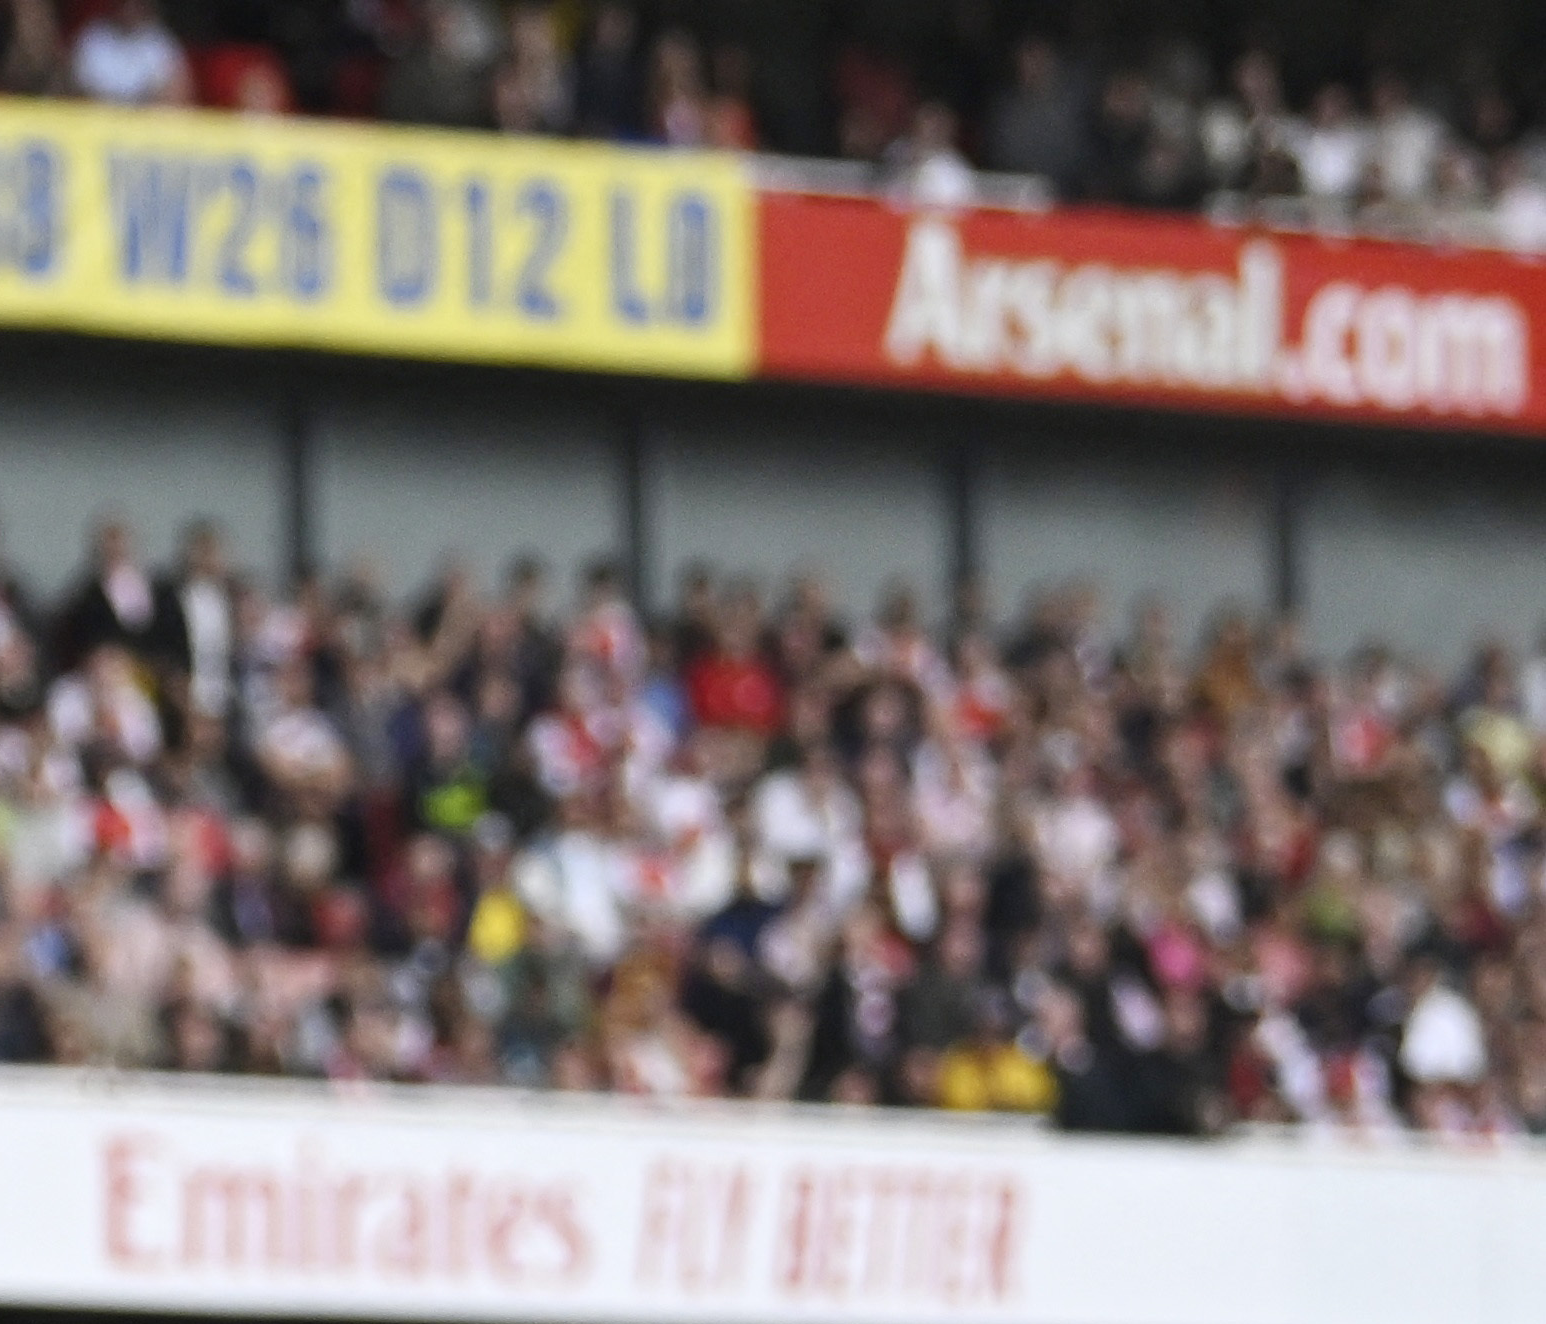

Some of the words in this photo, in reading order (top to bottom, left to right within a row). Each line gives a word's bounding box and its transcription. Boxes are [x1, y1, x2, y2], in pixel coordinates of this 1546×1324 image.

[109, 144, 334, 304] W26
[882, 216, 1528, 418] Arsenal.com
[99, 1132, 596, 1288] Emirates
[633, 1160, 754, 1292] FLY
[770, 1166, 1028, 1304] BETTER
